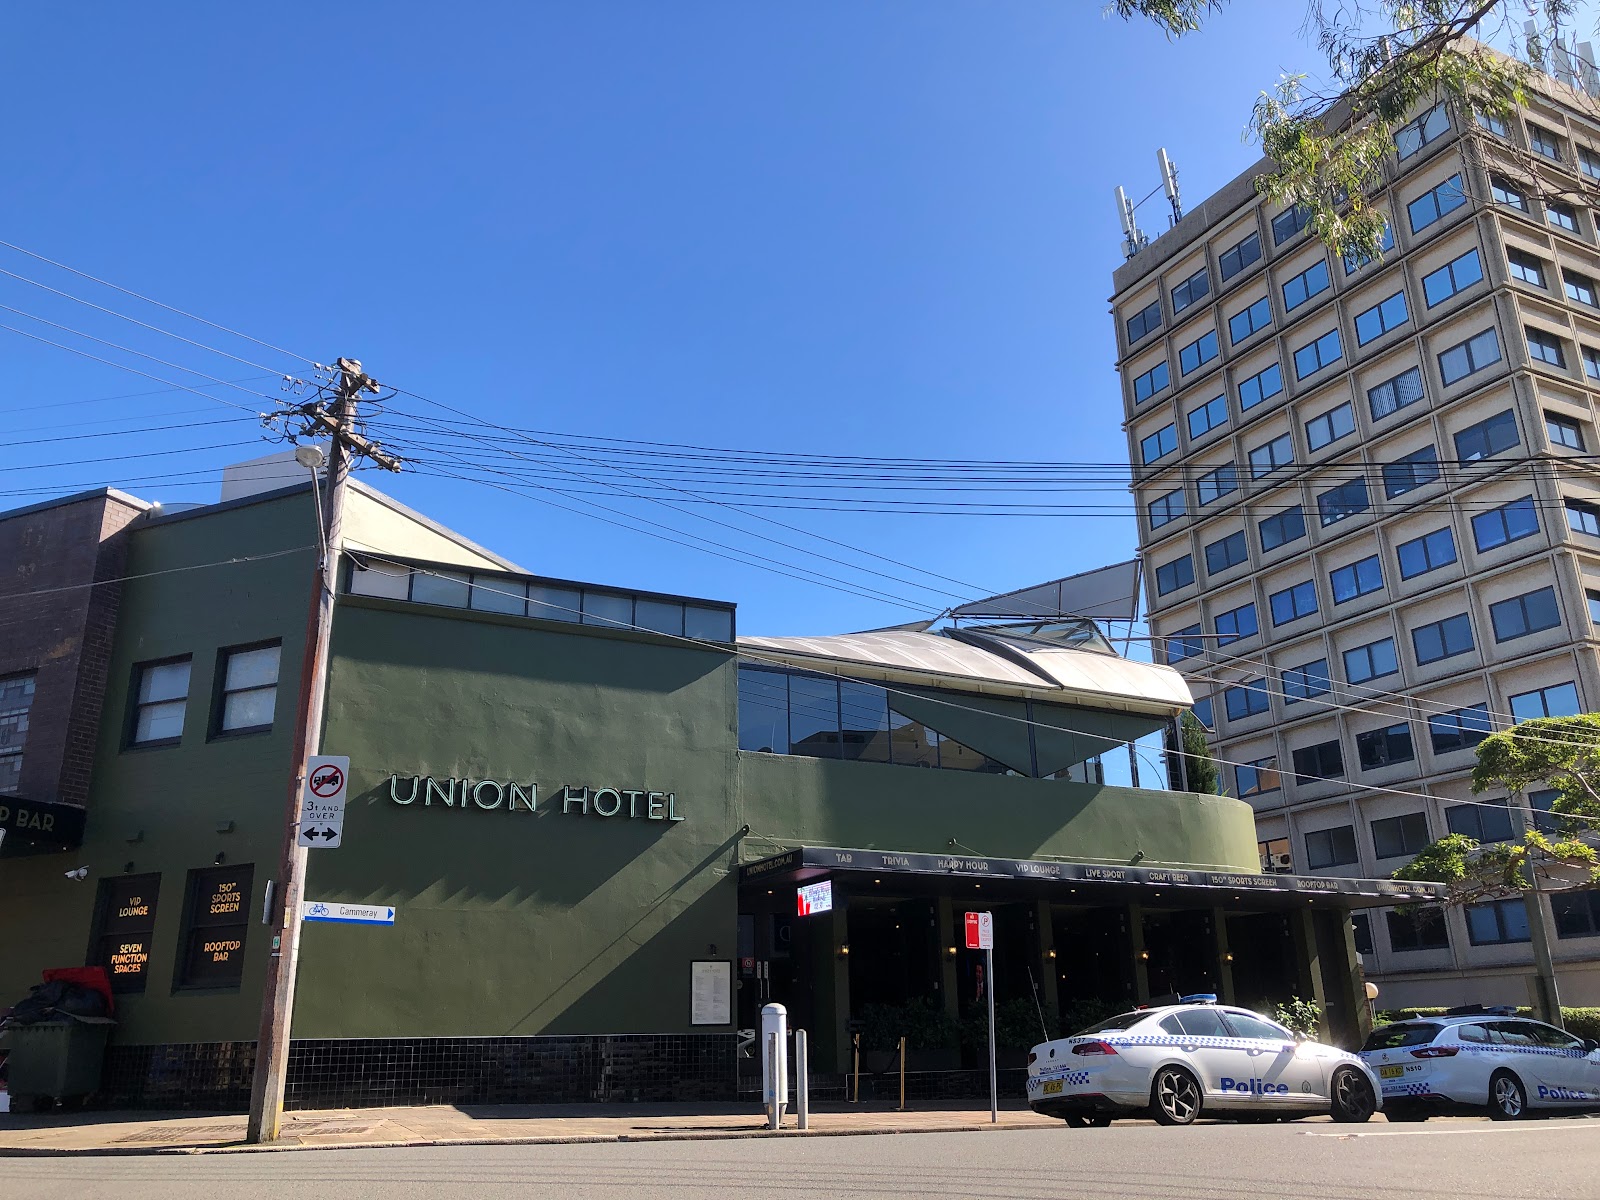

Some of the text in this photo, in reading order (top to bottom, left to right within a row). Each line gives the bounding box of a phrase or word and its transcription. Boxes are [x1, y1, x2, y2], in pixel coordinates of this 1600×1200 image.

[390, 774, 685, 821] UNION HOTEL
[306, 801, 318, 811] 3t
[16, 809, 54, 832] BAR
[836, 854, 852, 862] TAB
[882, 856, 909, 866] TRIVIA
[938, 859, 988, 870] HAPPY HOUR
[1016, 864, 1060, 875] VIP LOUNGE
[1086, 868, 1126, 879] LIVE SPORT
[1149, 872, 1189, 882] CRAFT BEER
[1228, 876, 1252, 885] SPORTS
[1253, 878, 1277, 886] SCREEN
[1297, 880, 1326, 889] ROOFTOP
[130, 896, 141, 906] VIP
[212, 892, 240, 903] SPORTS
[119, 906, 148, 917] LOUNGE
[210, 902, 239, 914] SCREEN
[340, 906, 378, 918] Cammeray
[120, 944, 142, 953] SEVEN
[204, 940, 240, 952] ROOFTOP
[111, 953, 147, 964] FUNCTION
[213, 952, 229, 962] BAR
[114, 964, 141, 974] SPACES
[1220, 1078, 1289, 1095] Police
[1537, 1086, 1588, 1100] Police
